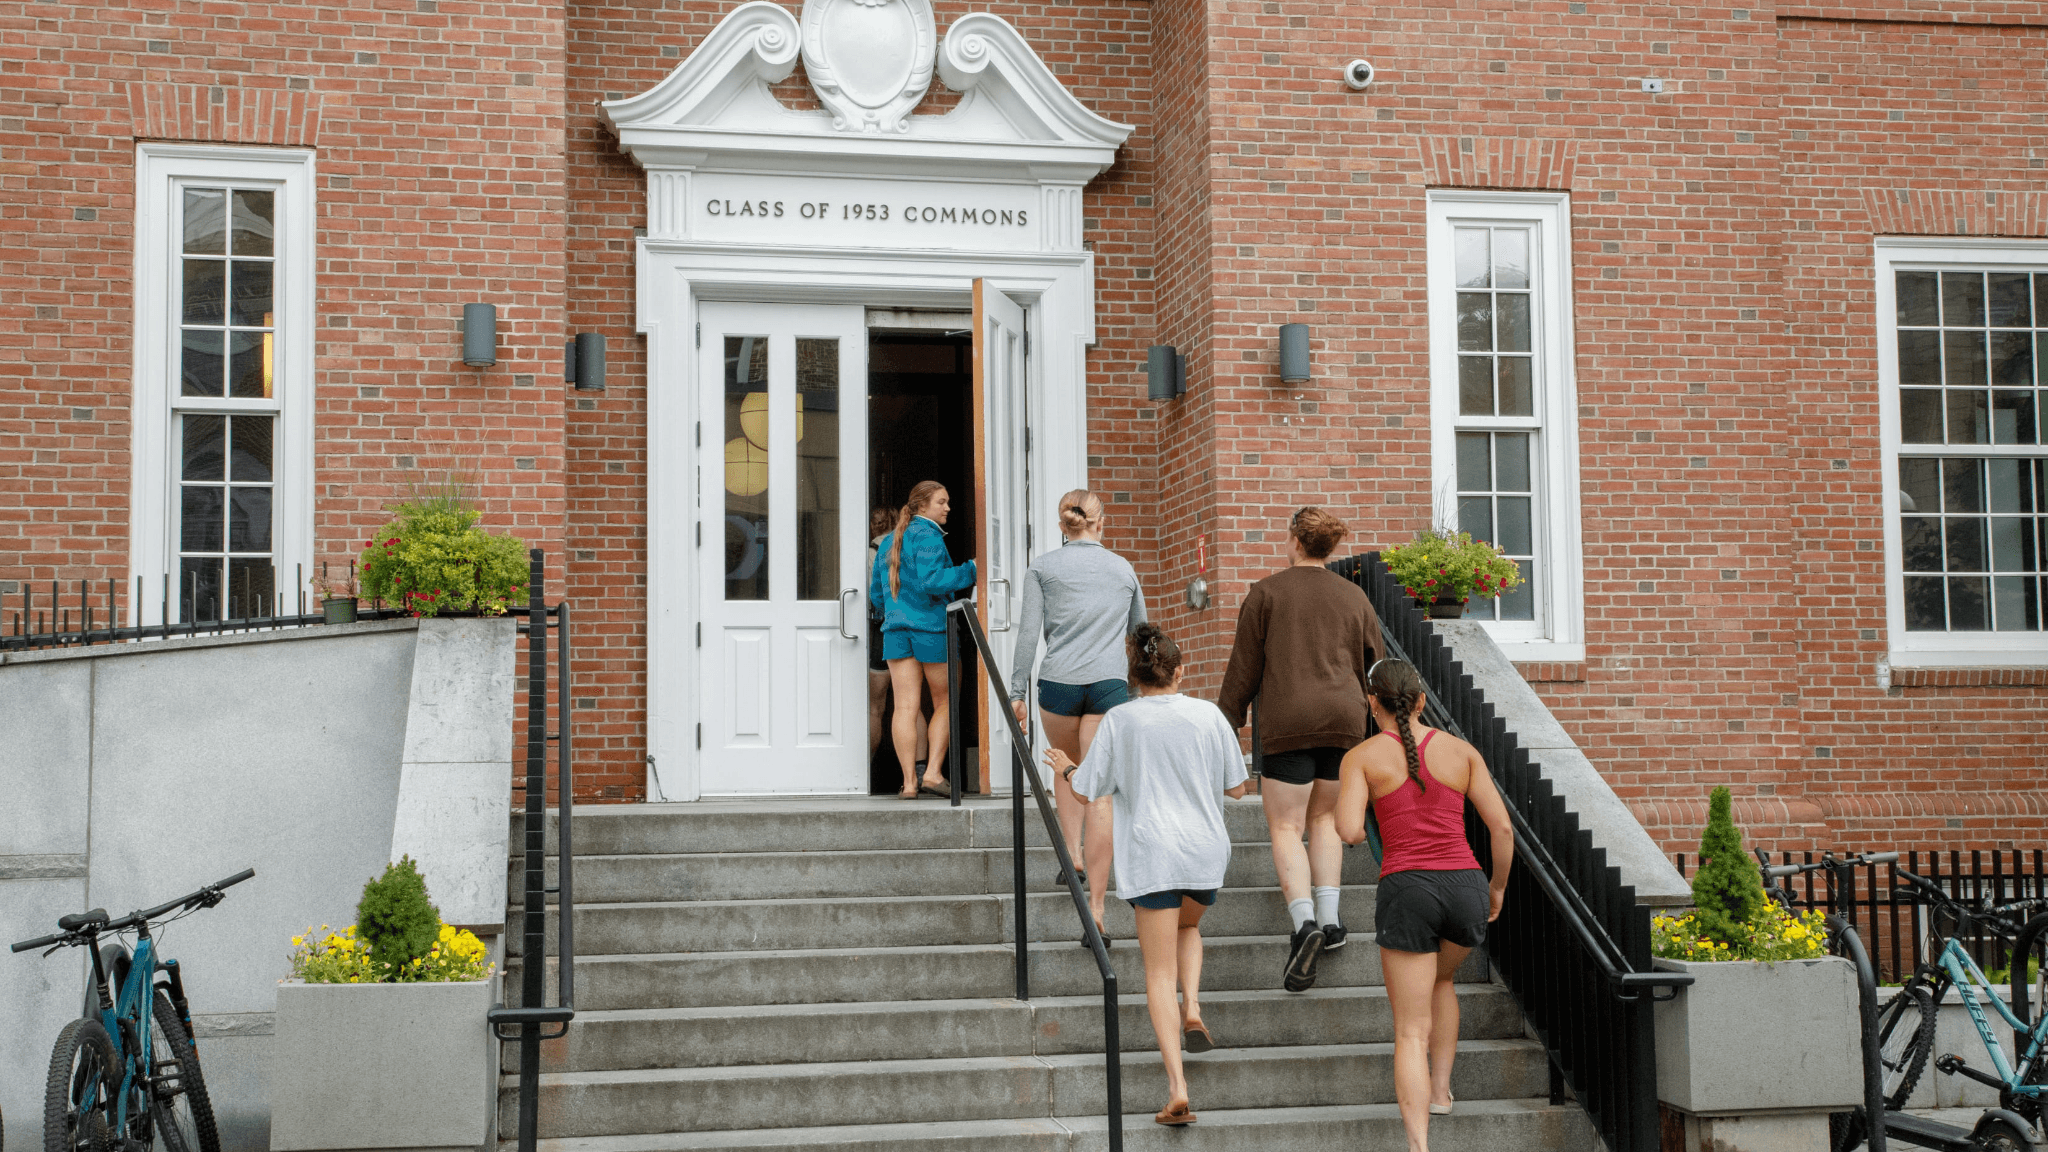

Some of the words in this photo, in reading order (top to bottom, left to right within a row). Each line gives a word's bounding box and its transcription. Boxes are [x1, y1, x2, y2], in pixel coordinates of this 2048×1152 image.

[706, 199, 784, 217] CLASS
[800, 202, 829, 219] OF
[843, 203, 889, 220] 1953
[904, 206, 1028, 226] COMMONS
